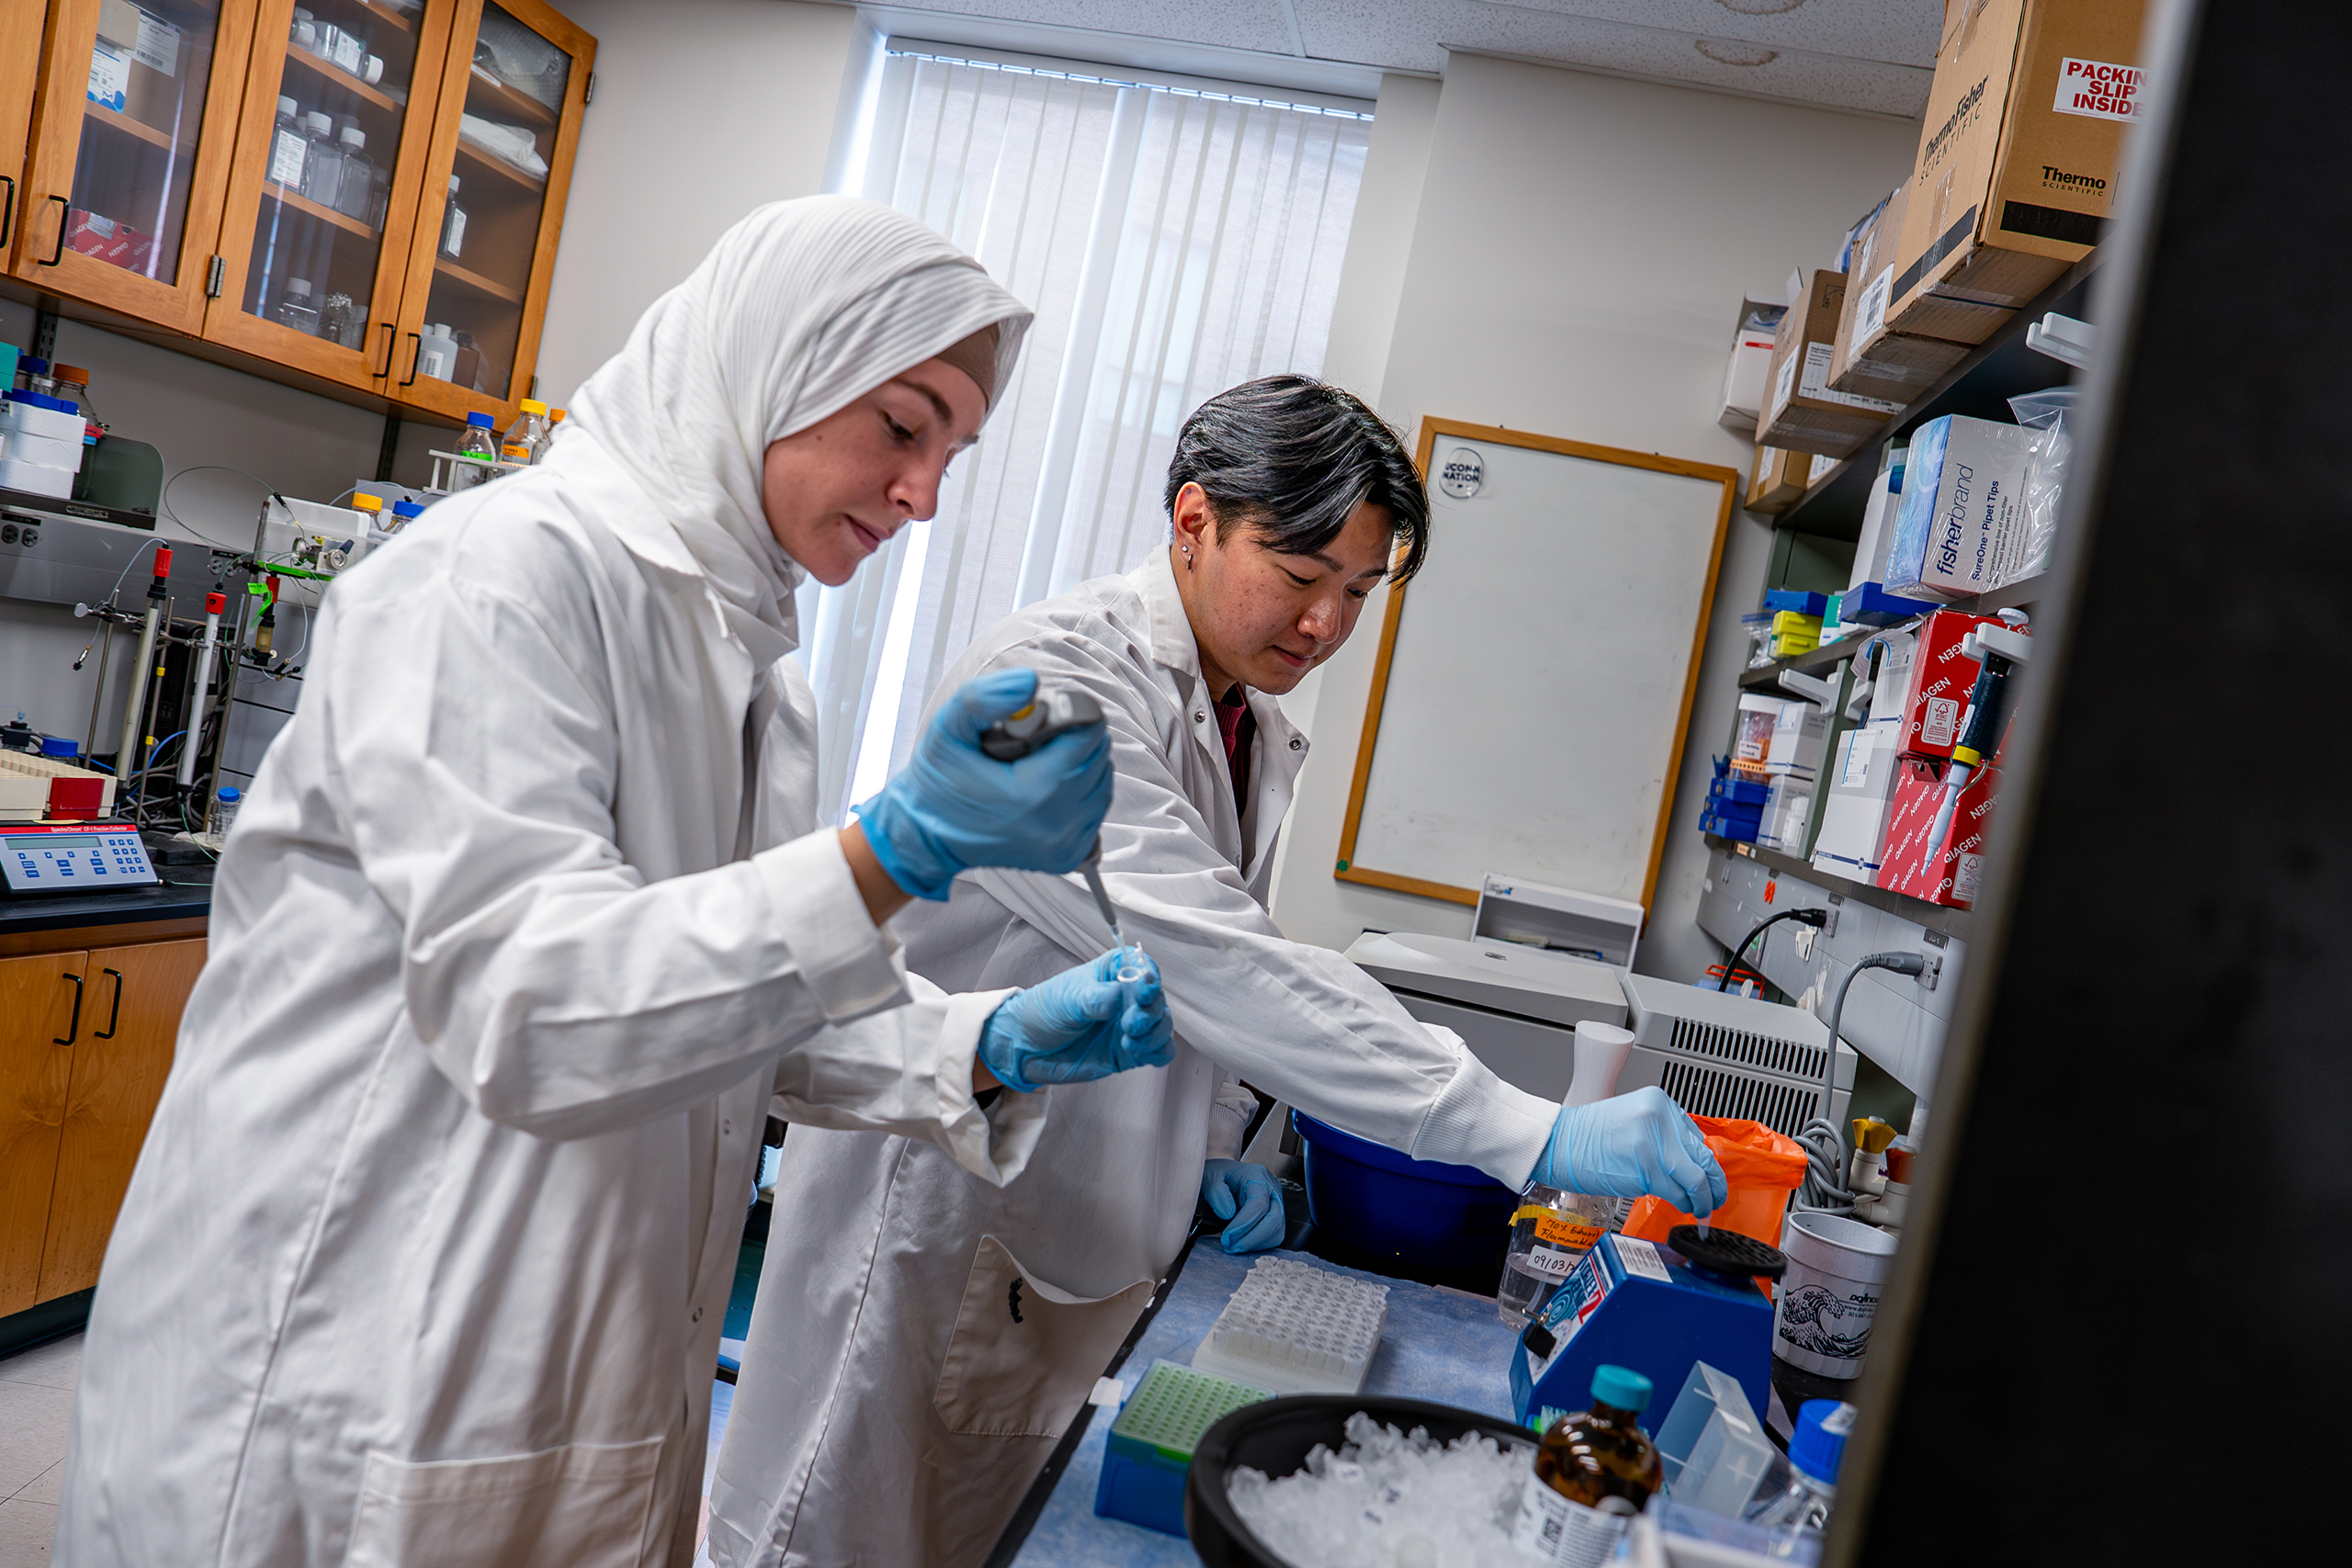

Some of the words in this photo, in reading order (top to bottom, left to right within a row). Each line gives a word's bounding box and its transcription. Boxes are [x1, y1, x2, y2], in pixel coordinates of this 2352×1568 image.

[2067, 61, 2148, 85] PACKIN
[2087, 80, 2137, 99] SLIP
[2073, 93, 2144, 117] INSIDE
[1918, 102, 1983, 187] SCIENTIFIC
[2041, 165, 2107, 190] Thermo
[2041, 181, 2104, 197] SCIENTIFIC
[84, 243, 104, 257] IAGEN
[108, 242, 129, 258] QIAGEN
[1442, 471, 1480, 483] NATION
[1445, 462, 1481, 474] UCONN
[1987, 479, 1999, 502] Tips
[1936, 462, 1974, 576] fisherbrand
[1982, 504, 1995, 531] Pipet
[1938, 642, 1963, 664] GEN
[1931, 770, 1951, 801] QIAGE
[1910, 784, 1930, 818] QIAGEN
[1892, 800, 1909, 831] QIAGEN
[1915, 814, 1935, 847] QIAGEN
[1894, 829, 1913, 861] QIAGEN
[1943, 832, 1983, 864] QIAGEN
[1900, 858, 1918, 890] QIAGEN
[1929, 876, 1953, 903] QIAGE
